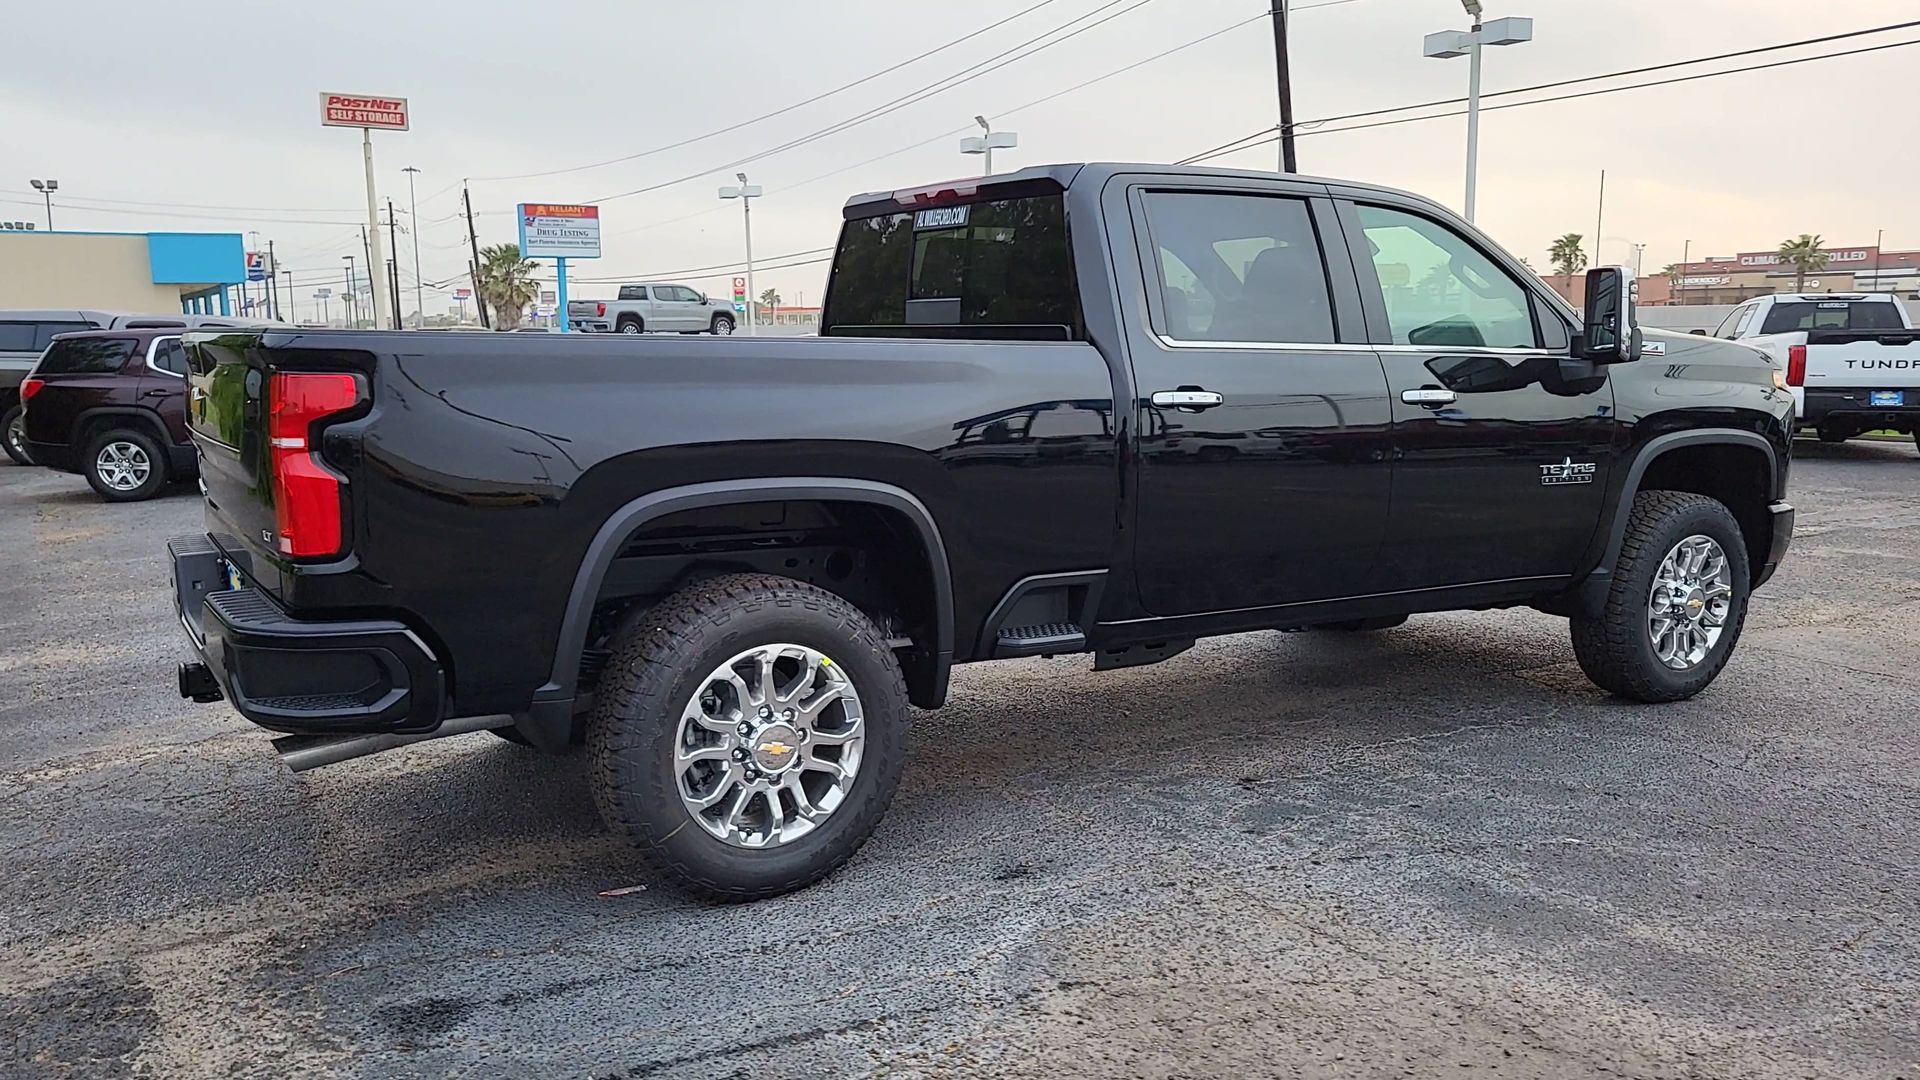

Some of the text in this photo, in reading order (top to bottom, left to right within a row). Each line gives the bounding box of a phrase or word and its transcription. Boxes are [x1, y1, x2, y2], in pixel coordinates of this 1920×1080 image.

[330, 109, 403, 124] SELF STORAGE
[549, 205, 587, 213] RELIANT
